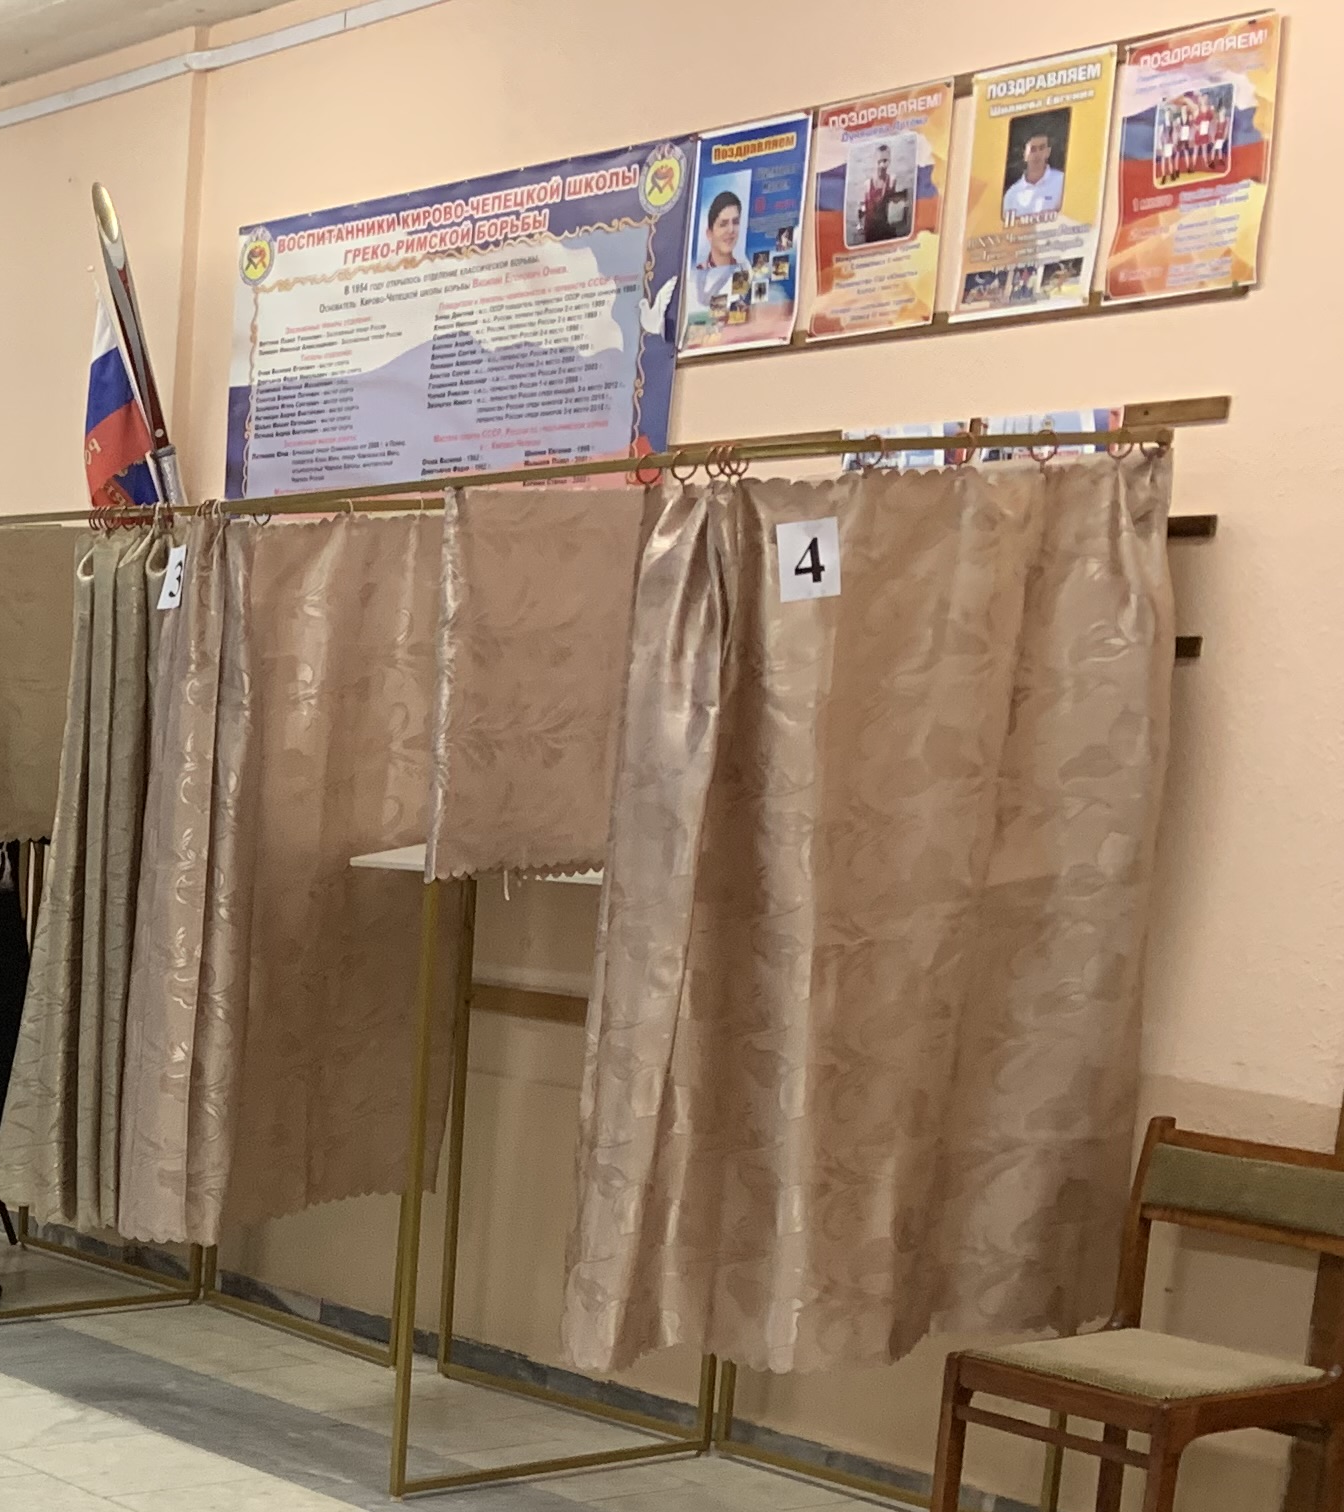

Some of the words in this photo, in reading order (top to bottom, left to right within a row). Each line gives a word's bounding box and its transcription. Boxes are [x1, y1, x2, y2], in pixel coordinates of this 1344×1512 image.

[1140, 29, 1268, 68] ПОЗДРАВЛЯЕМ!
[987, 63, 1102, 100] ПОЗДРАВЛЯЕМ
[828, 92, 943, 129] ПОЗДРАВЛЯЕМ!
[712, 132, 797, 164] Поздравляем
[277, 220, 397, 254] ВОСПИТАННИКИ
[400, 177, 562, 229] КИРОВО-ЧЕПЕЦКОЙ
[565, 166, 639, 199] ШКОЛЫ
[343, 223, 473, 265] ГРЕКО-РИМСКОЙ
[475, 209, 549, 246] БОРЬБЫ
[169, 560, 183, 597] 3
[795, 537, 825, 583] 4
